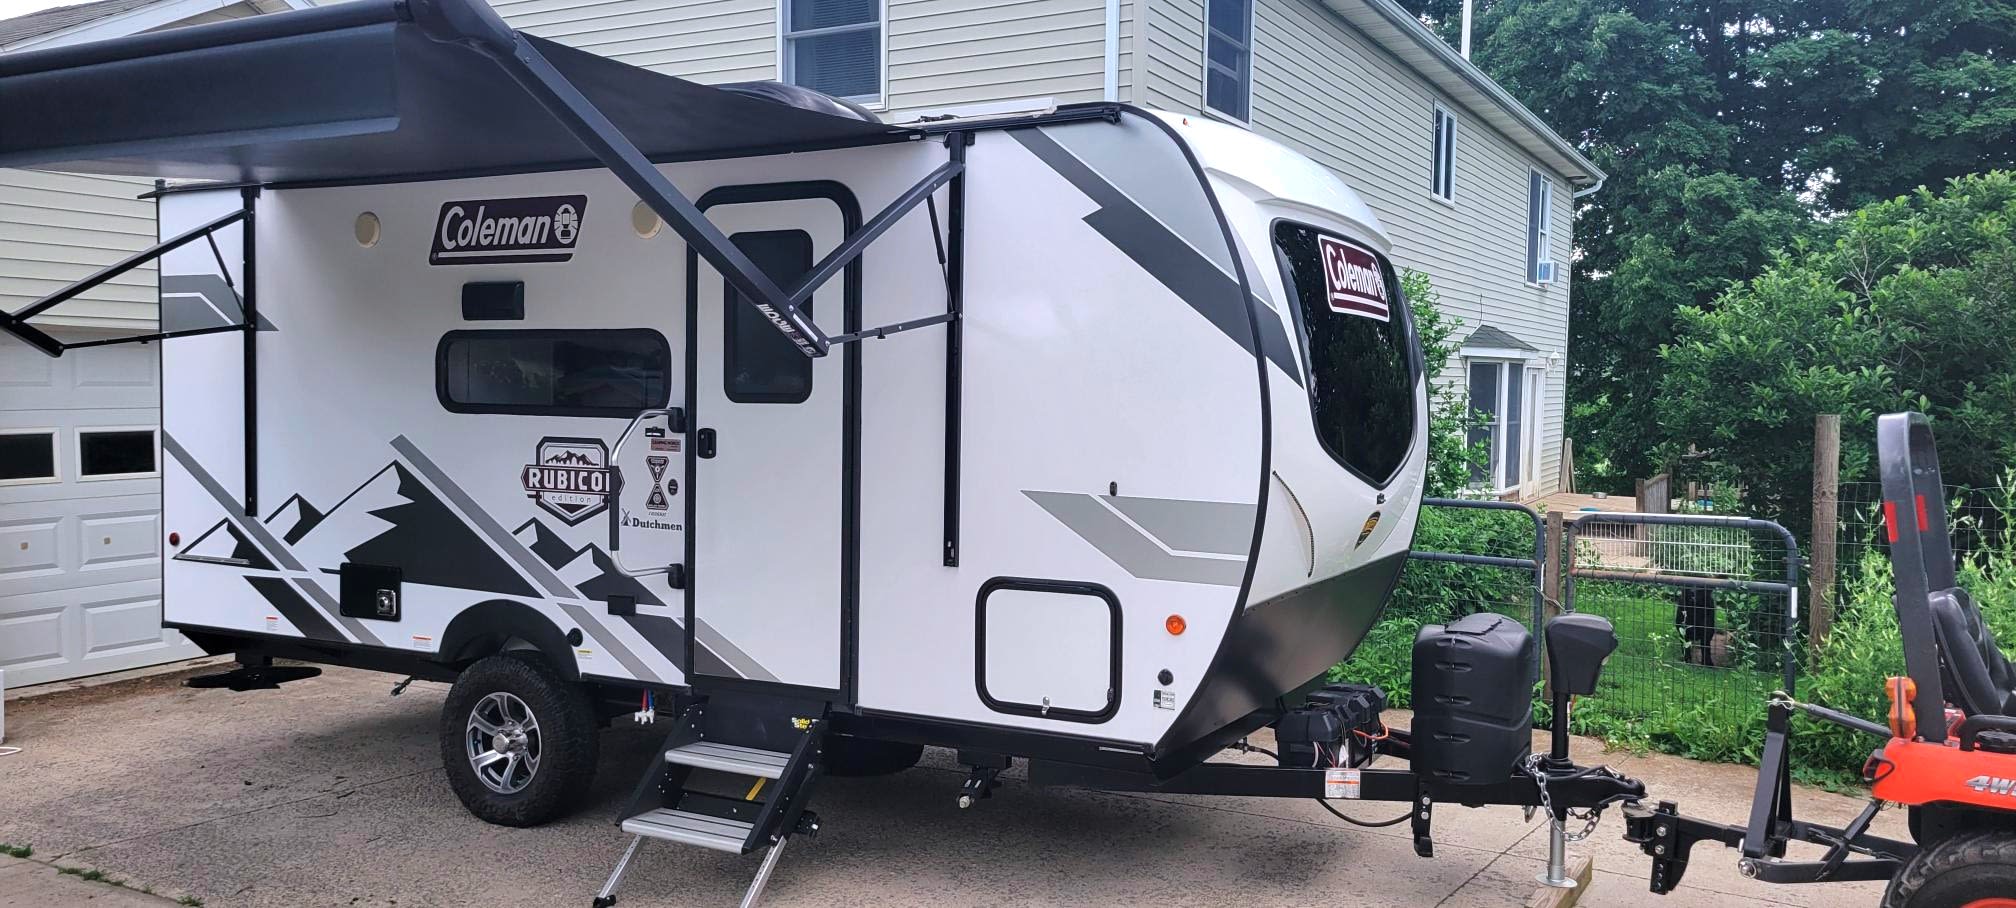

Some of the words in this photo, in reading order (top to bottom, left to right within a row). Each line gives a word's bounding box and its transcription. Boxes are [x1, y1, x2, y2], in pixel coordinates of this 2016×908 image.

[441, 205, 551, 250] Coleman
[1325, 244, 1378, 297] Coleman
[551, 494, 592, 503] edition
[632, 518, 683, 532] Dutchmen
[1966, 775, 2016, 797] 4W
